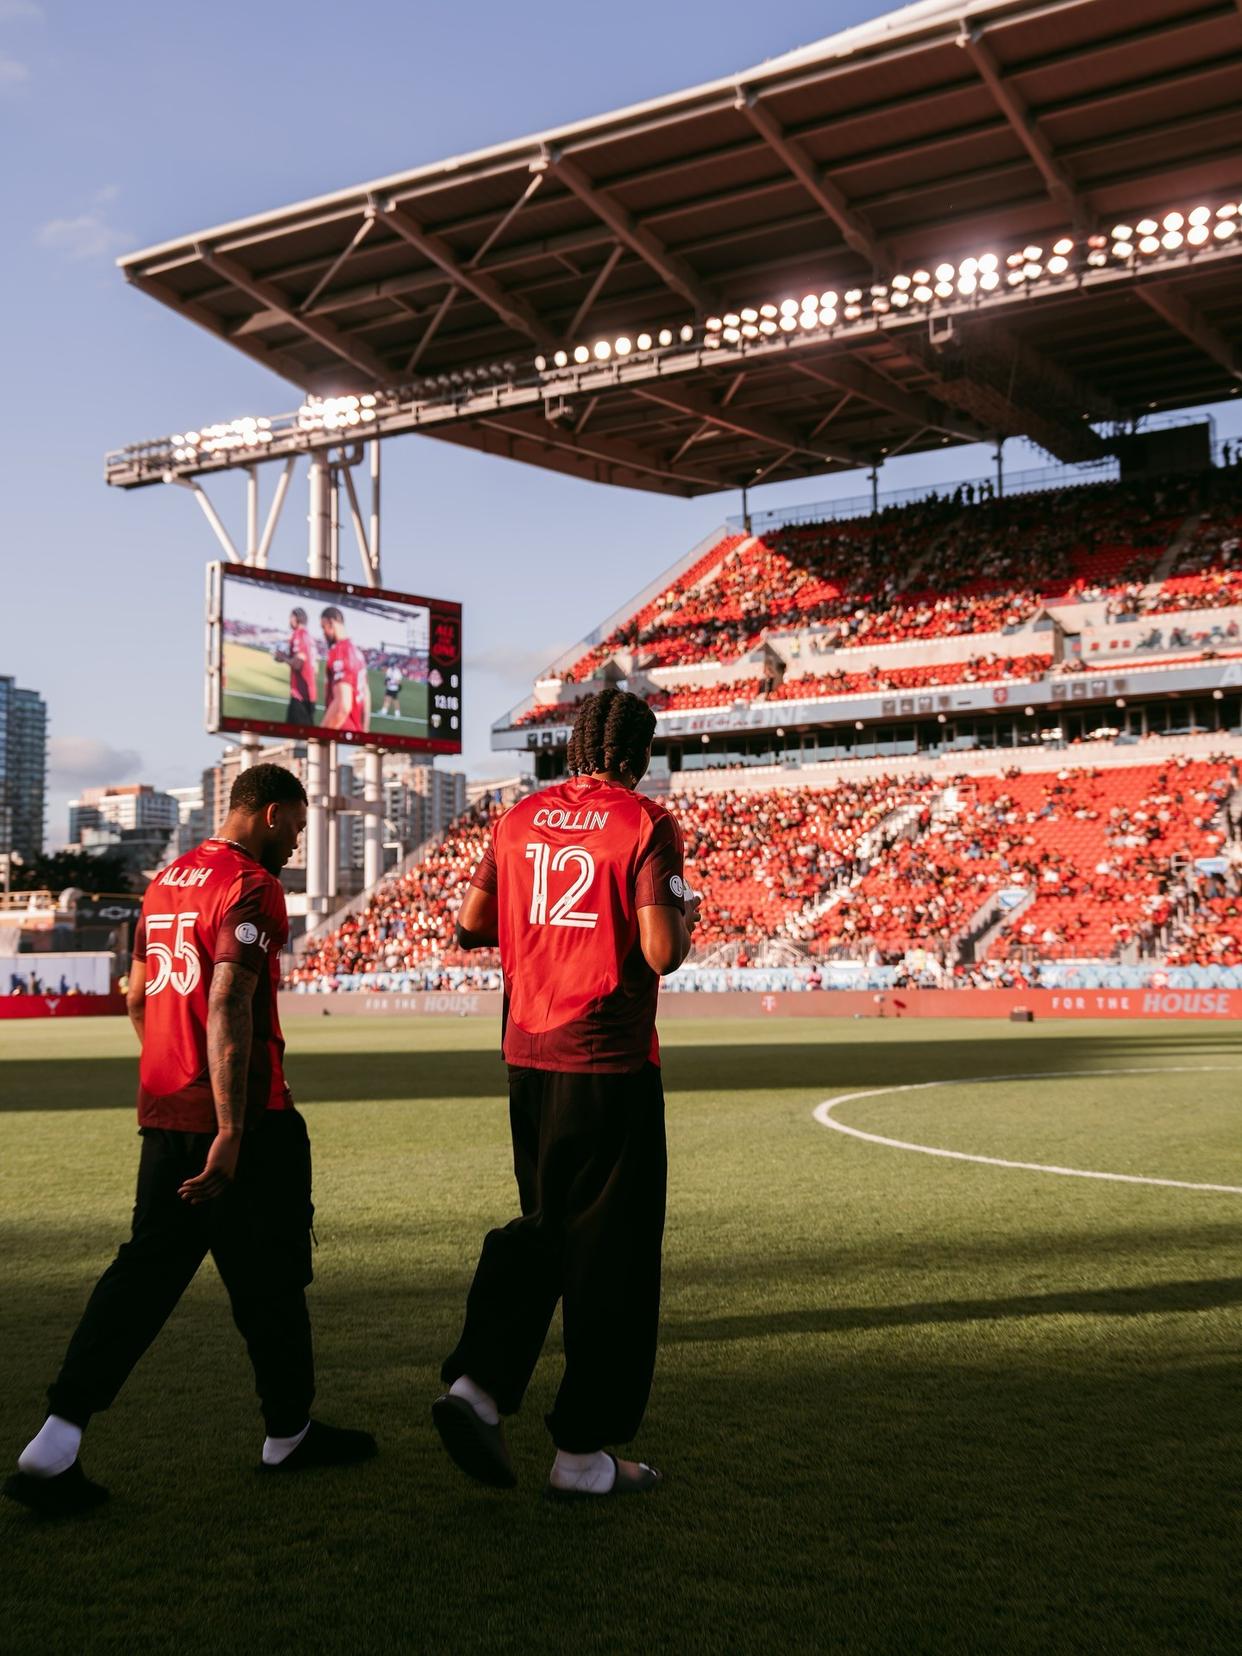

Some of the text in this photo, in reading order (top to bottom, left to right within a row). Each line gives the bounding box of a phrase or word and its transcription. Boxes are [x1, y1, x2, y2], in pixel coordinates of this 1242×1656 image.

[533, 808, 609, 830] COLLIN
[525, 842, 599, 929] 12
[145, 911, 201, 996] 55
[365, 995, 481, 1013] FOR THE HOUSE
[1051, 992, 1231, 1014] FOR THE HOUSE
